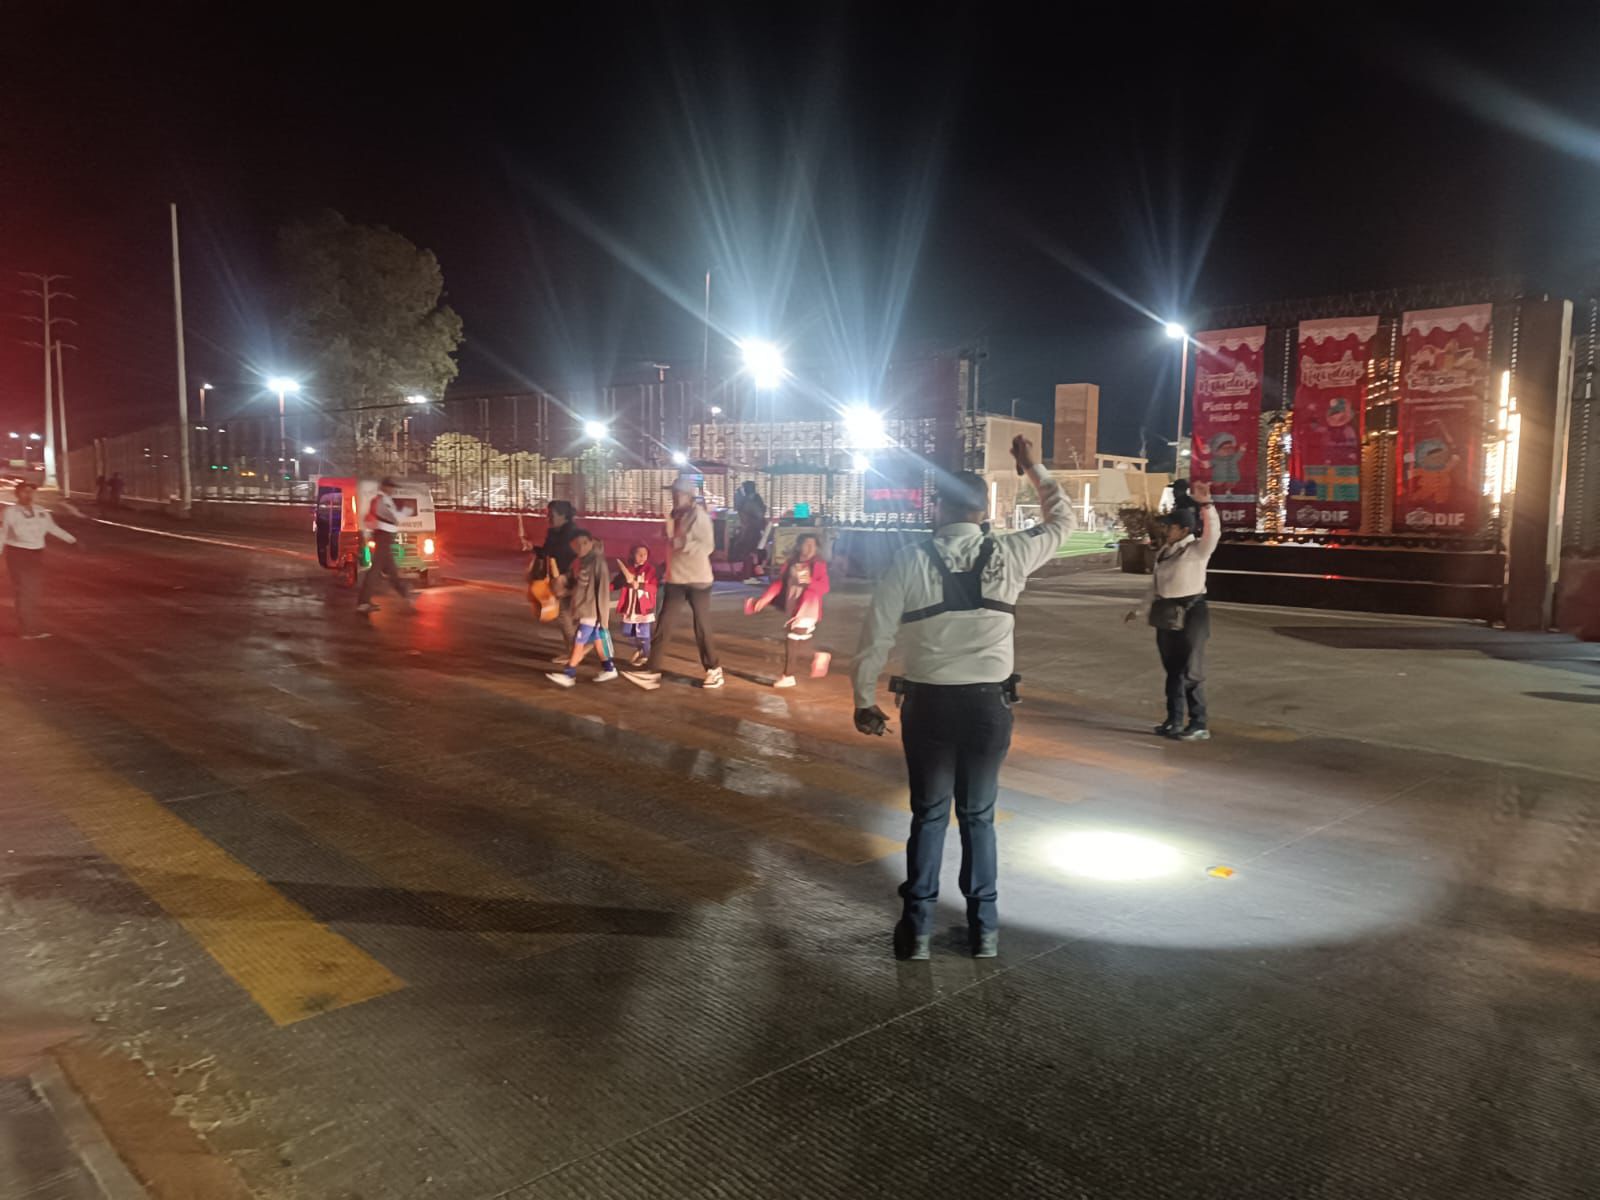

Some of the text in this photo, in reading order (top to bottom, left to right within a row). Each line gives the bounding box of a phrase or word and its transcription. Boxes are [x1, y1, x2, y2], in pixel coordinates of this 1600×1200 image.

[1222, 509, 1247, 521] DIF
[1321, 510, 1349, 523] DIF
[1434, 512, 1465, 526] DIF
